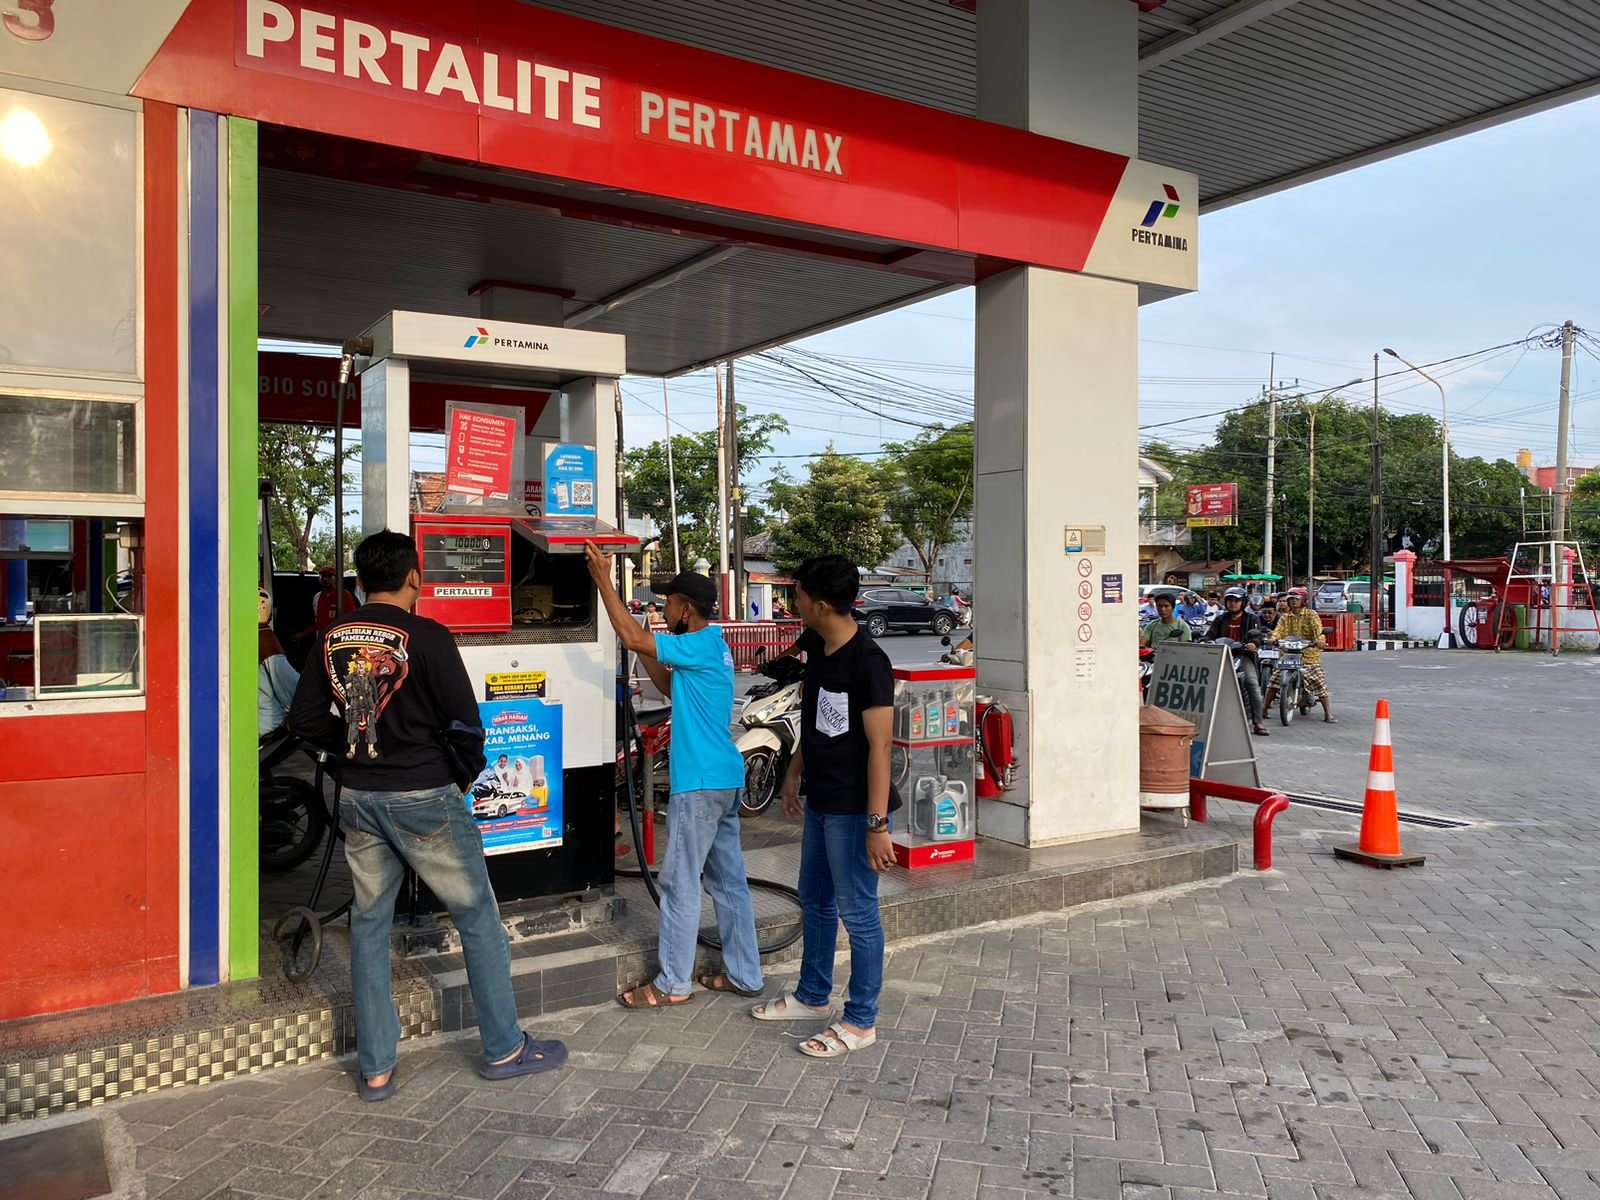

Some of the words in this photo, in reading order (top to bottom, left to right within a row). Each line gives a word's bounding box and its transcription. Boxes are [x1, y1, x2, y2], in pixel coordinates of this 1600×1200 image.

[245, 0, 601, 129] PERTALITE
[640, 90, 843, 175] PERTAMAX
[1131, 228, 1188, 252] PERTAMINA
[494, 338, 549, 351] PERTAMINA
[258, 375, 294, 396] BIO
[302, 378, 356, 400] SOLA
[436, 588, 490, 596] PERTALITE
[1160, 663, 1209, 685] JALUR
[1154, 682, 1207, 713] BBM
[484, 735, 507, 745] KAR,
[508, 732, 550, 743] MENANG
